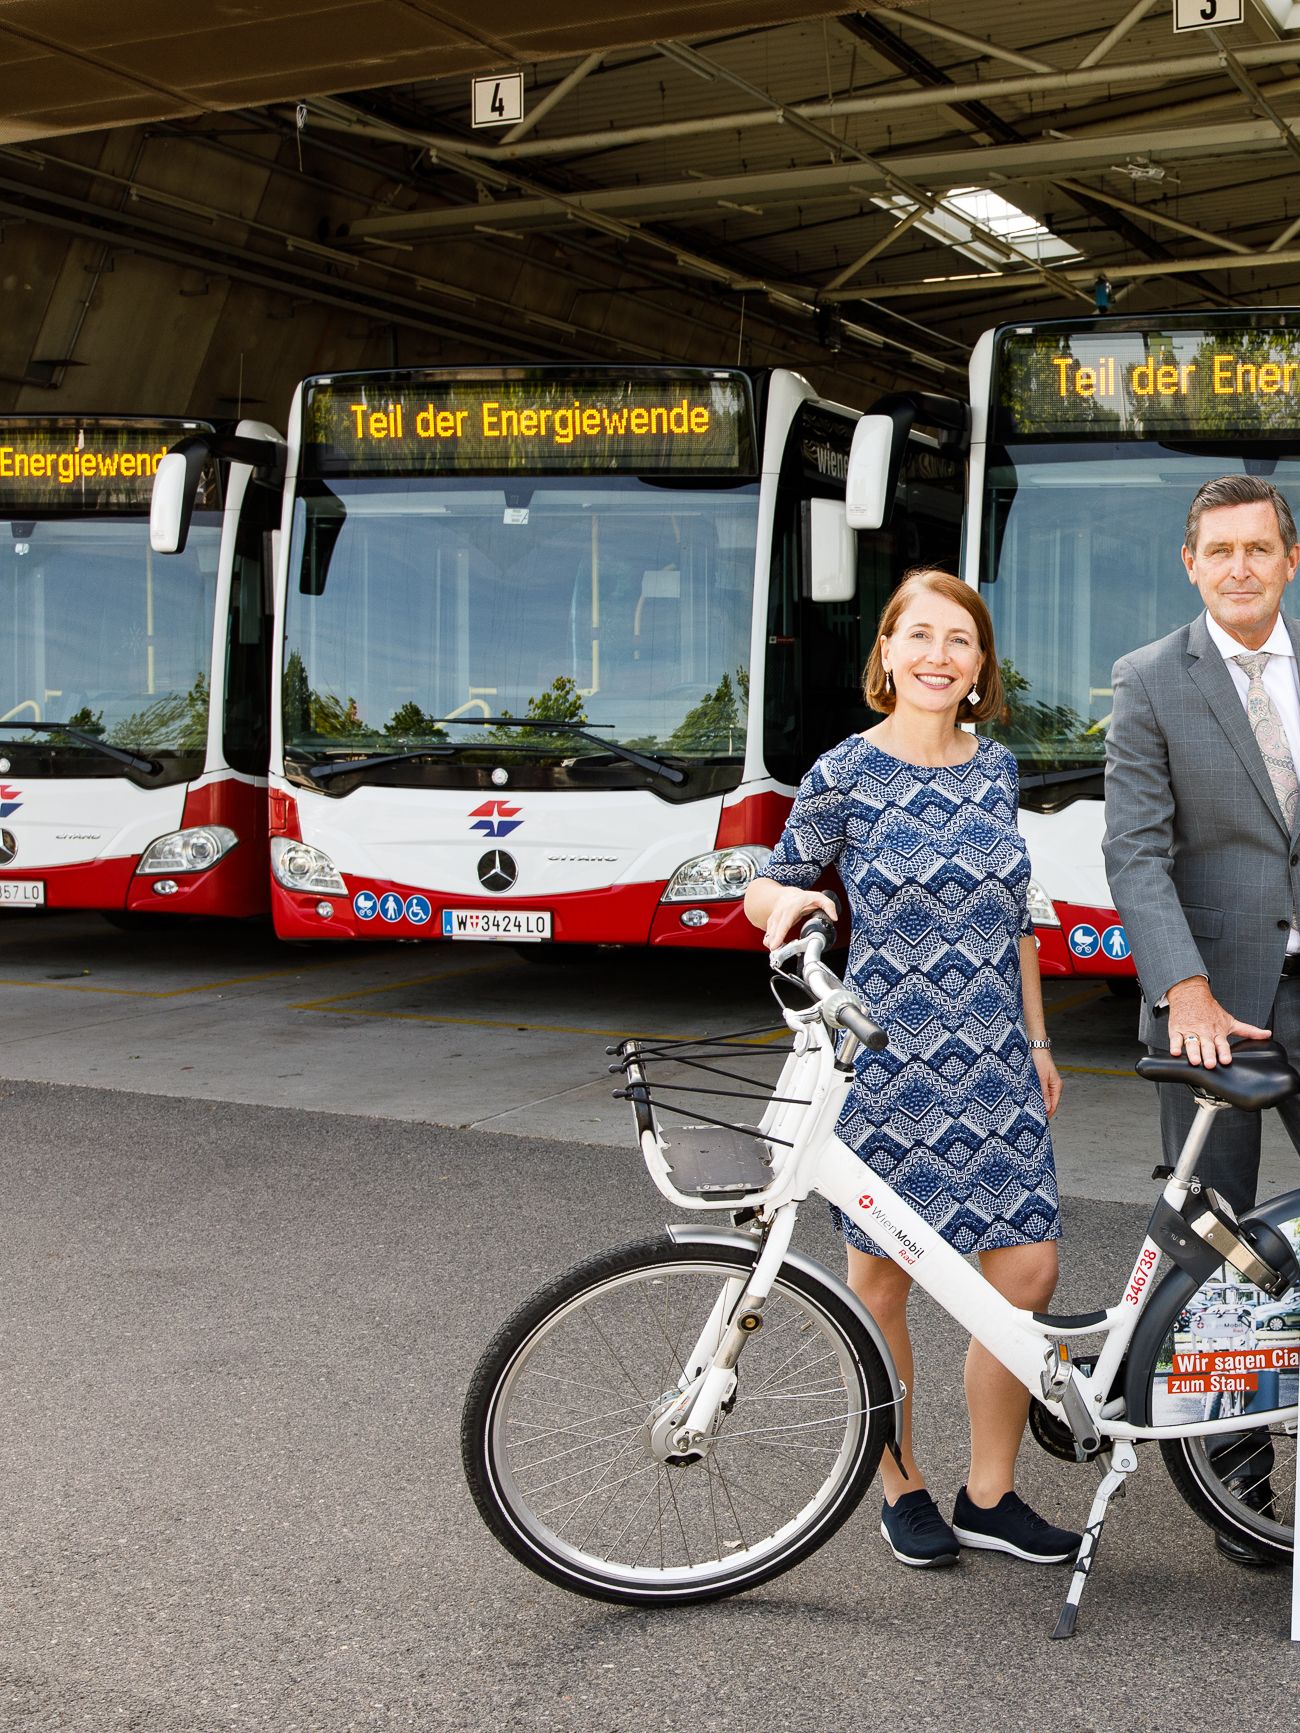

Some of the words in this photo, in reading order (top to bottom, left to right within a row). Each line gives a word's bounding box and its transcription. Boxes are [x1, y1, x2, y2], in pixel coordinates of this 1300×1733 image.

[491, 83, 504, 117] 4
[1053, 357, 1115, 397] Teil
[1132, 356, 1196, 395] der
[351, 403, 403, 439] Teil
[416, 403, 469, 438] der
[482, 399, 710, 444] Energiewende
[0, 446, 168, 484] Energiewend
[817, 442, 849, 479] wiene
[0, 885, 19, 900] 57
[456, 914, 468, 931] W
[871, 1206, 925, 1259] WienMobil
[898, 1248, 917, 1265] Rad
[1125, 1249, 1157, 1306] 346738
[1177, 1355, 1209, 1373] Wir
[1214, 1353, 1266, 1374] sagen
[1271, 1349, 1300, 1371] Cia
[1171, 1379, 1205, 1393] zum
[1210, 1376, 1250, 1392] Stau.
